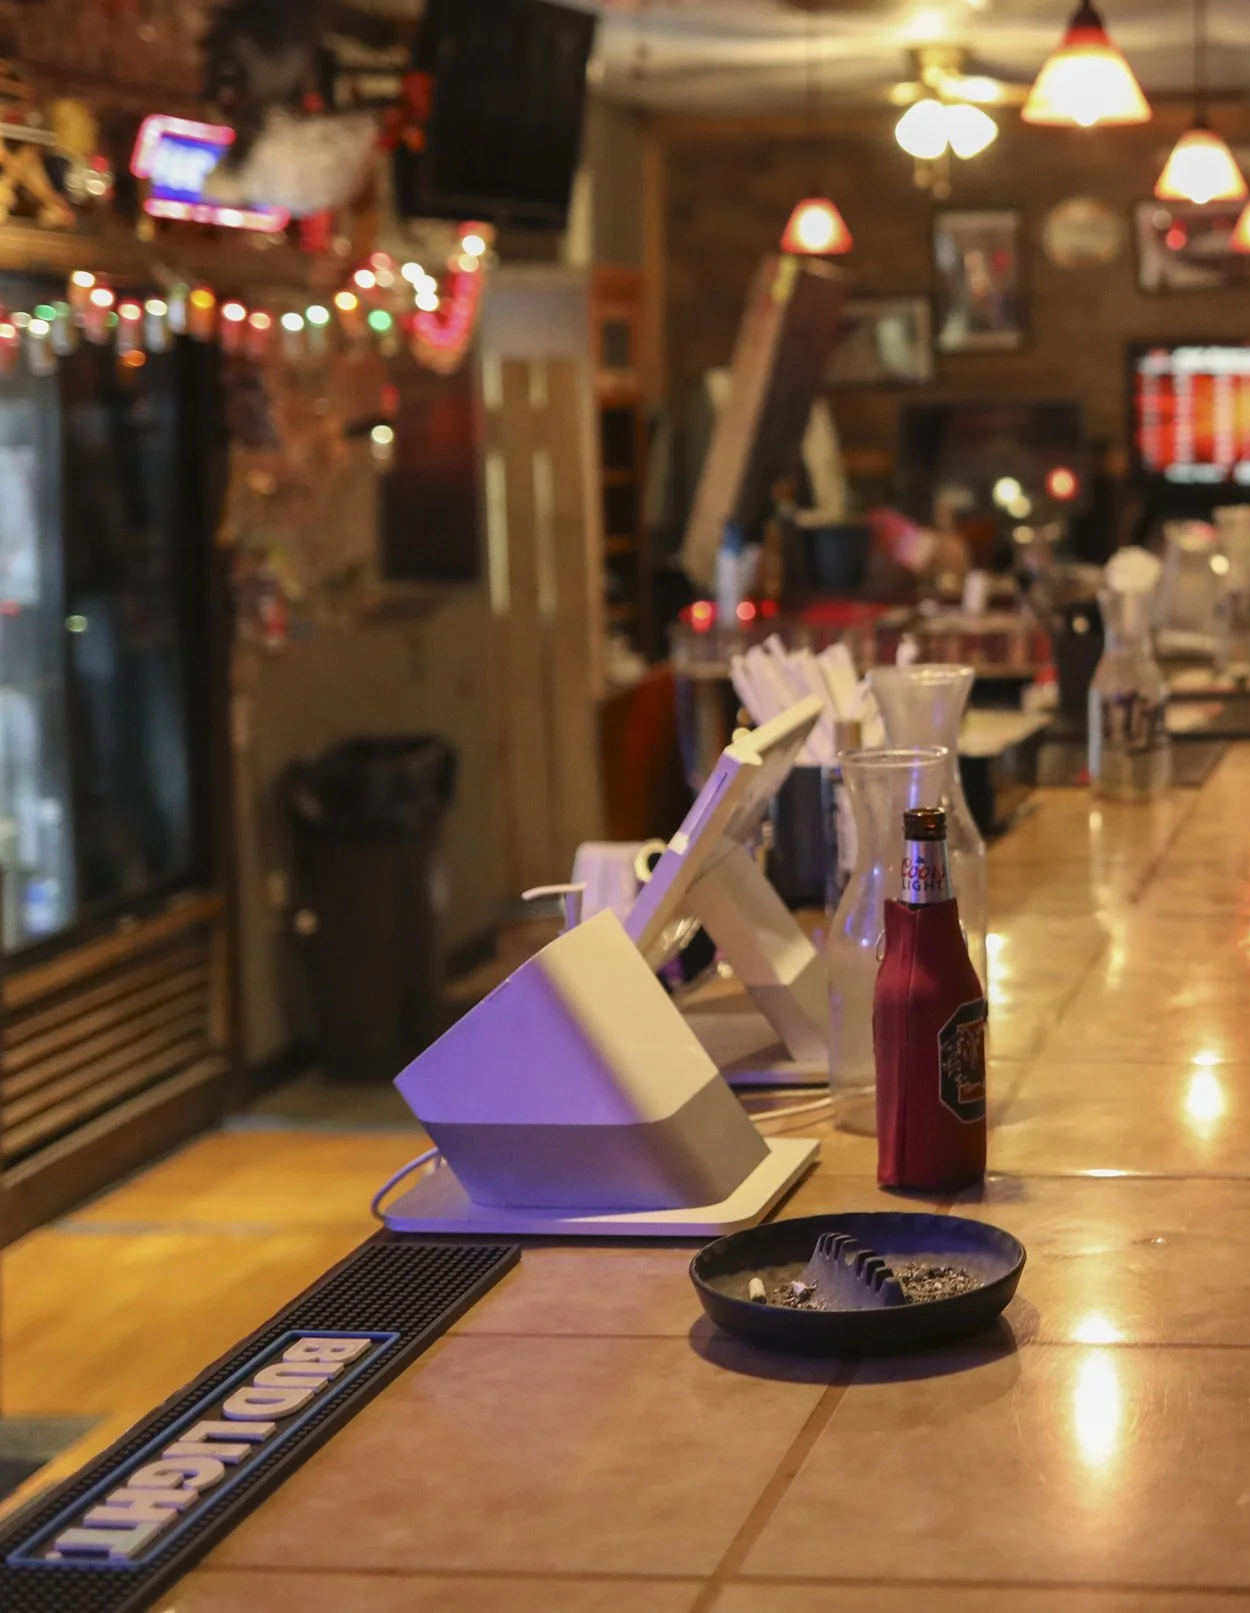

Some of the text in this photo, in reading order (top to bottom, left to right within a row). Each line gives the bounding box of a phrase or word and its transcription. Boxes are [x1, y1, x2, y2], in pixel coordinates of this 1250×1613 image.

[901, 878, 943, 891] LIGHT
[54, 1337, 372, 1562] BUD LIGHT
